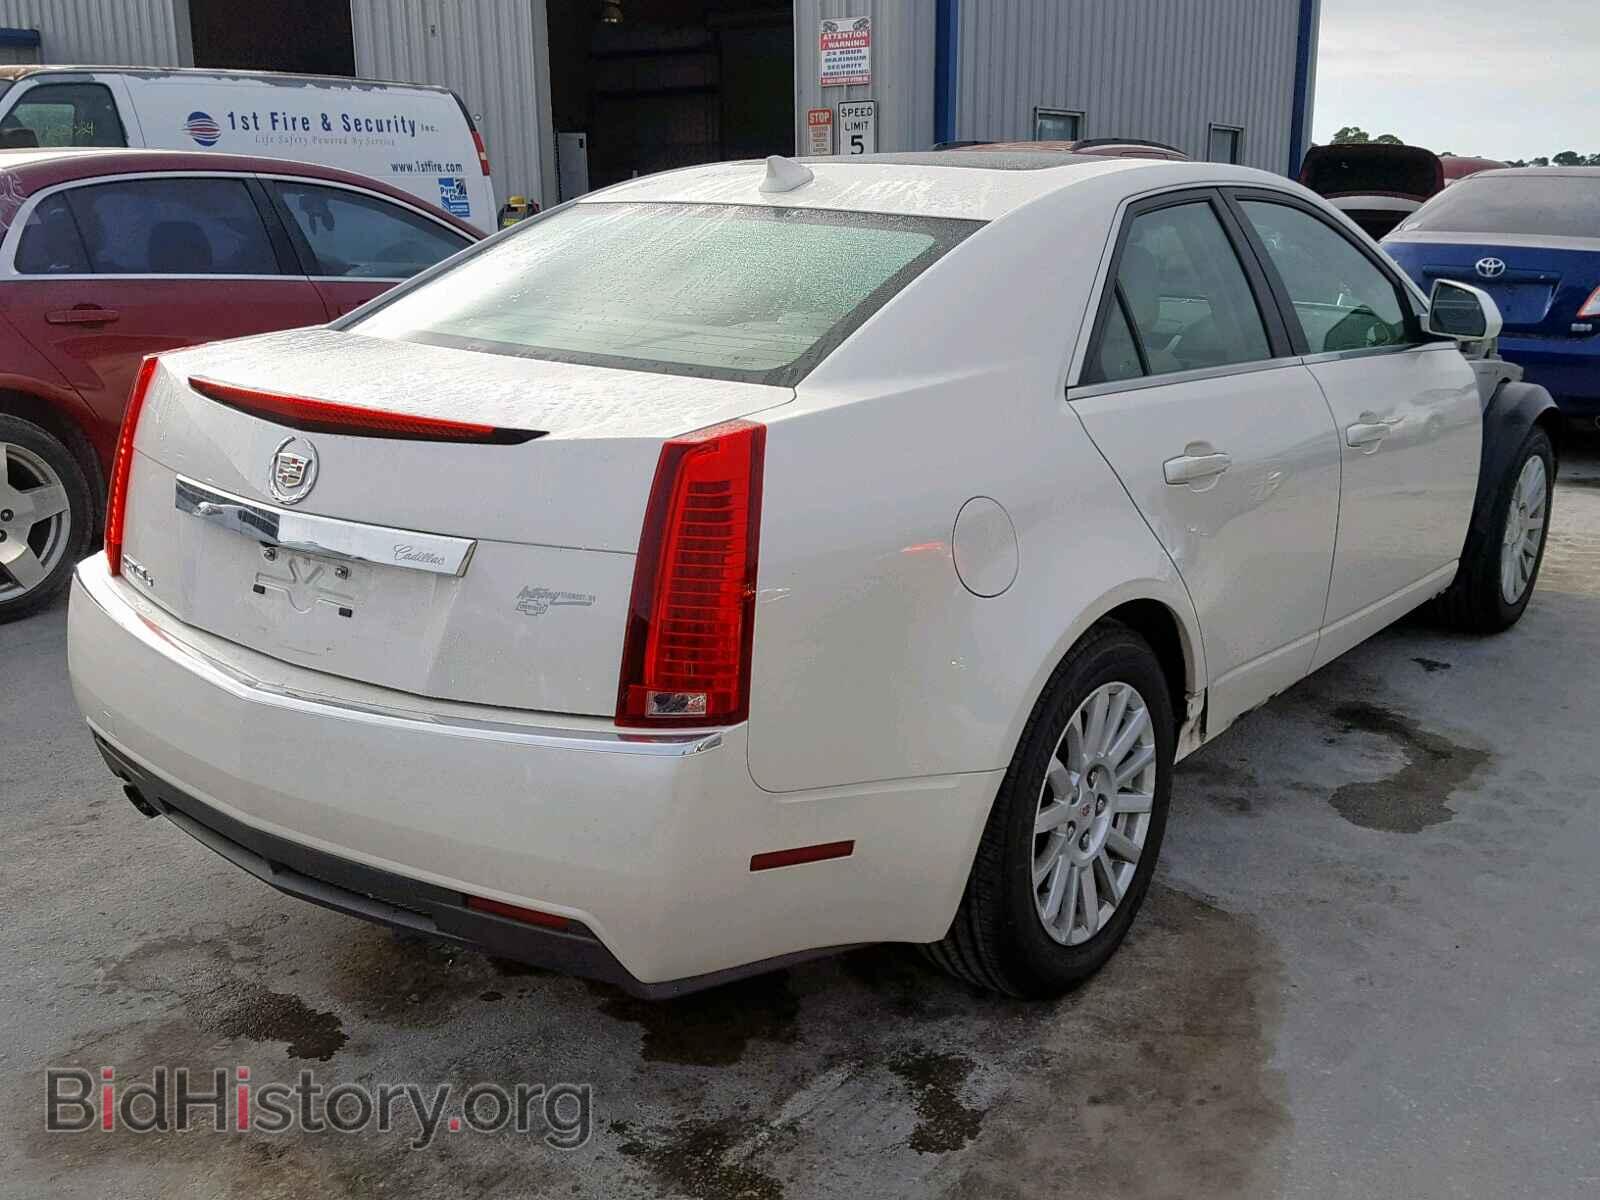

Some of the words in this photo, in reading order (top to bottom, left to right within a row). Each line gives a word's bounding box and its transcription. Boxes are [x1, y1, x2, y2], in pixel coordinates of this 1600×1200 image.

[823, 31, 868, 40] ATTENTION
[828, 40, 865, 49] WARNING
[809, 112, 830, 124] STOP
[841, 107, 873, 117] SPEED
[227, 111, 260, 131] 1st
[270, 111, 310, 131] Fire
[321, 112, 332, 131] &
[341, 113, 416, 137] Security
[845, 120, 868, 131] LIMIT
[851, 134, 864, 154] 5
[390, 160, 463, 173] www.1stfire.com
[394, 545, 446, 566] Cadillac
